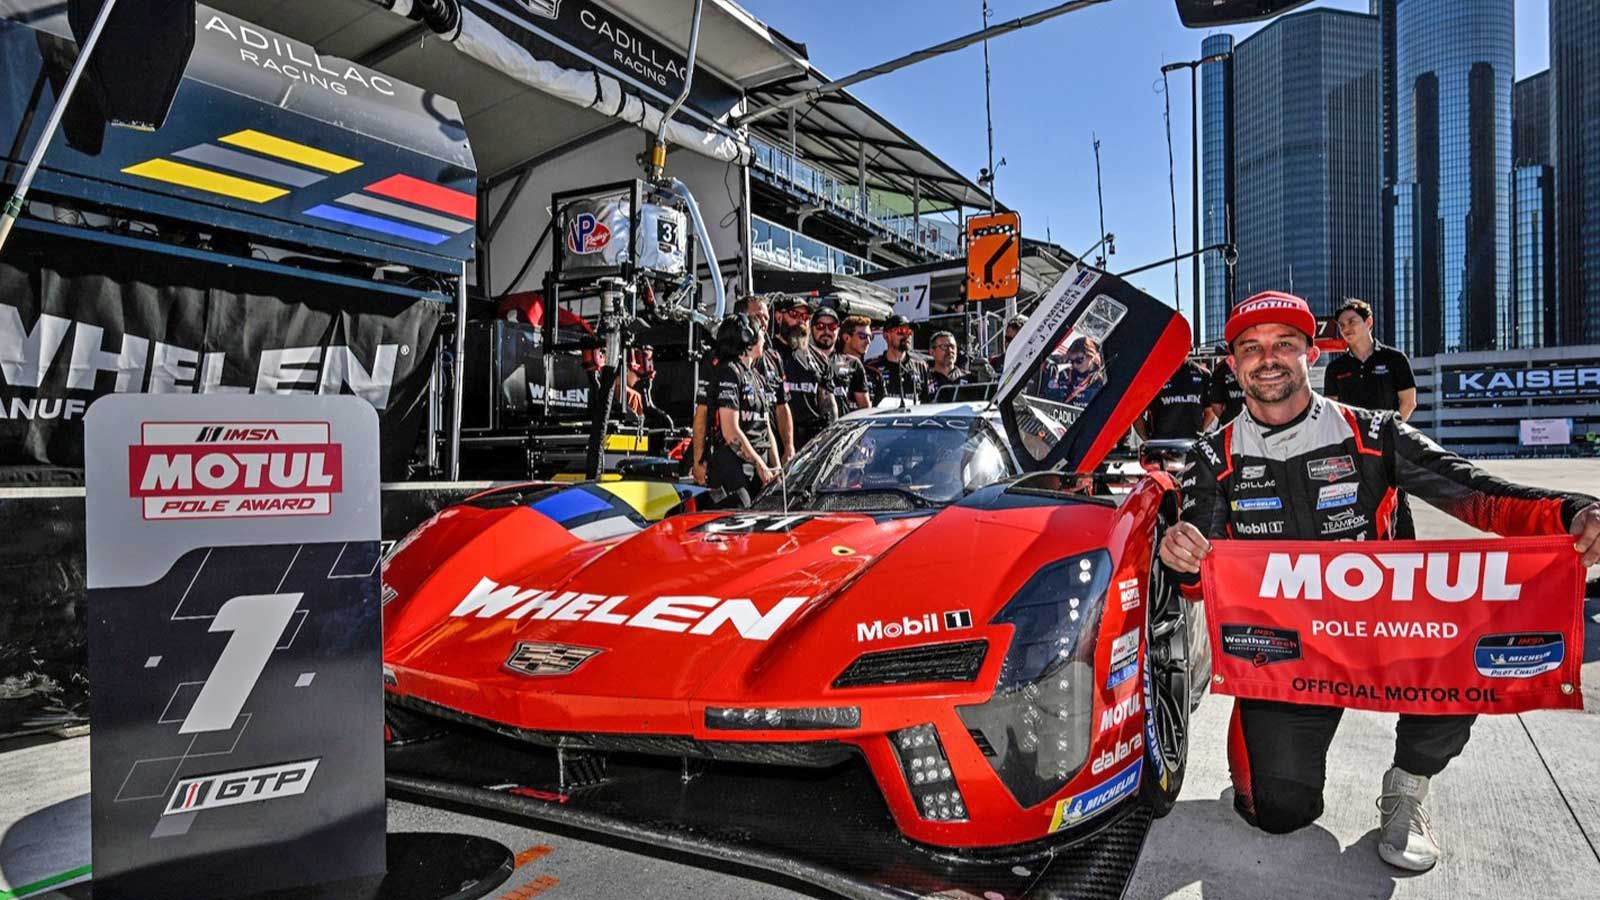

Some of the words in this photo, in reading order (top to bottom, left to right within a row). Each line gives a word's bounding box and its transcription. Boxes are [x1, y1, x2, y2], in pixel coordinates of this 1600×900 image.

[197, 15, 395, 96] ADILLAC
[239, 48, 348, 96] RACING
[613, 48, 667, 87] RACING
[914, 285, 928, 310] 7
[1047, 289, 1081, 331] AITKEN
[1316, 321, 1328, 335] 7
[223, 428, 280, 441] IMSA
[139, 452, 334, 490] MOTUL
[160, 500, 230, 514] POLE
[236, 497, 316, 511] AWARD
[1236, 521, 1268, 534] Mobil
[1259, 551, 1522, 603] MOTUL
[450, 576, 810, 641] WHELEN
[856, 613, 939, 642] Mobil
[1224, 636, 1297, 648] WeatherTech
[1311, 620, 1368, 637] POLE
[1373, 622, 1459, 639] AWARD
[178, 592, 305, 735] 1
[1508, 651, 1552, 662] MICHELIN
[1292, 677, 1381, 700] OFFICIAL
[1385, 685, 1460, 702] MOTOR
[1465, 687, 1501, 702] OIL
[1100, 692, 1141, 733] MOTUL
[1091, 732, 1143, 775] dallara
[215, 768, 306, 800] GTP
[1085, 771, 1137, 813] MICHELIN
